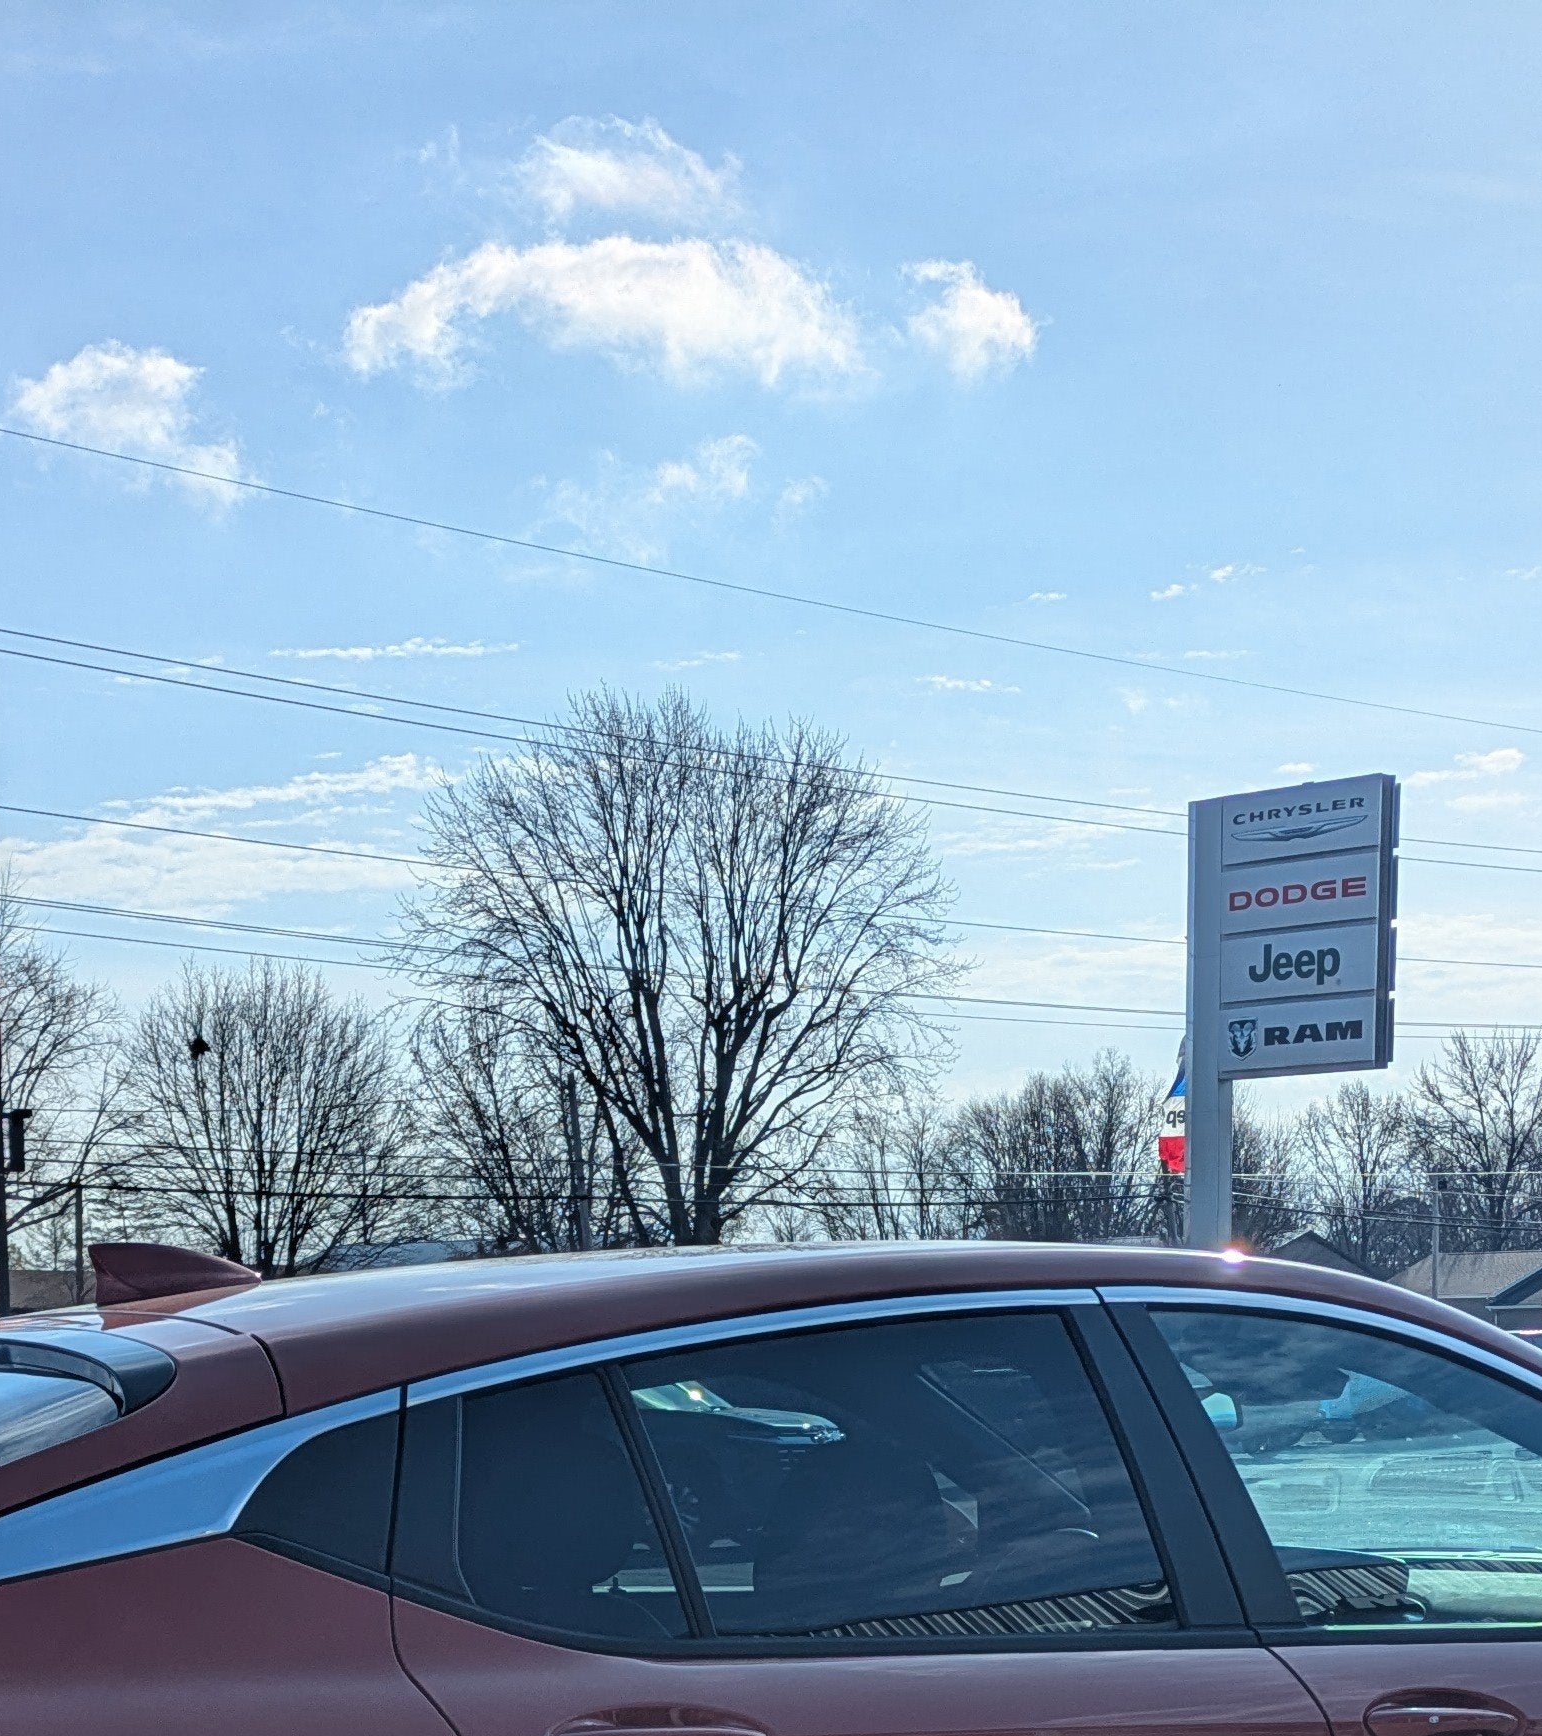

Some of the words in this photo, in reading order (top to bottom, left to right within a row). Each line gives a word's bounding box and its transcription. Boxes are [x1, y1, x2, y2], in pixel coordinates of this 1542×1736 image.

[1232, 797, 1365, 825] CHRYSLER
[1229, 876, 1367, 912] DODGE
[1248, 943, 1341, 985] Jeep
[1263, 1020, 1363, 1046] RAM
